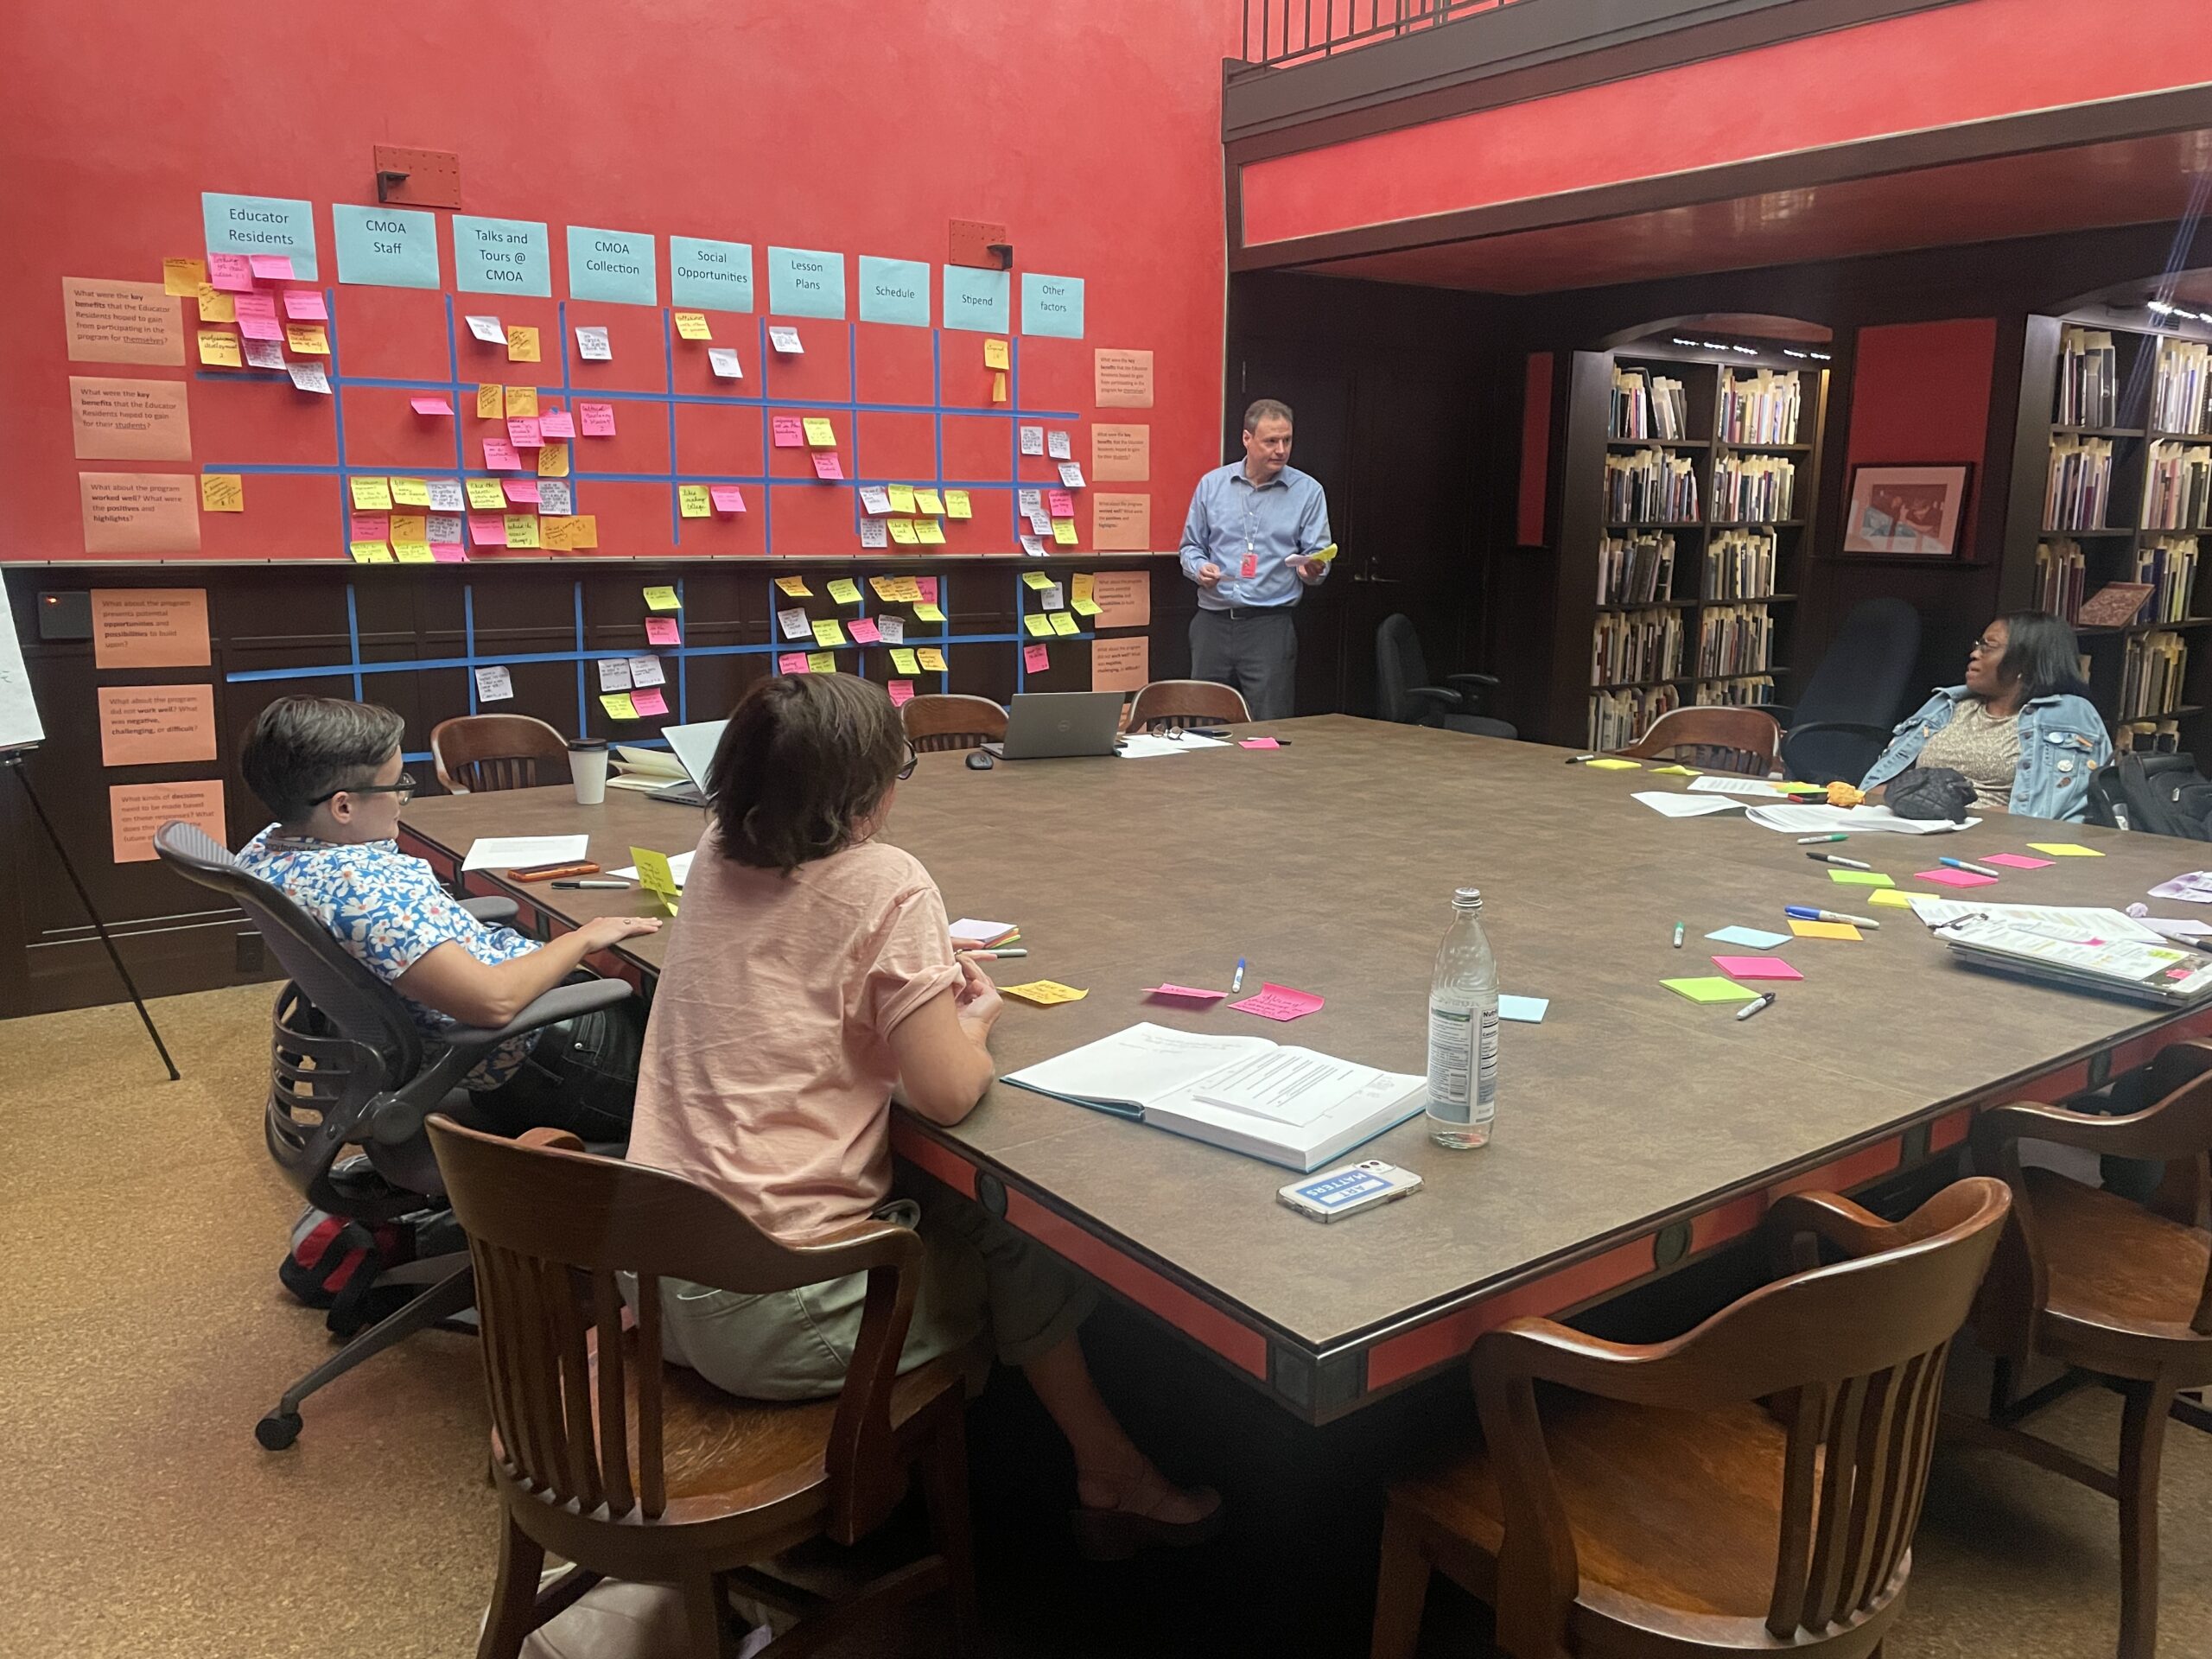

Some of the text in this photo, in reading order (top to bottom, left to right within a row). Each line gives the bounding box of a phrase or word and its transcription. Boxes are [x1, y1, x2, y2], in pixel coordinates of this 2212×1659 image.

[230, 208, 289, 223] Educator
[365, 220, 406, 234] CMOA
[229, 230, 293, 245] Residents
[475, 230, 528, 244] Talks and
[374, 242, 402, 254] Staff
[595, 242, 629, 254] CMOA
[480, 249, 525, 264] Tours @
[697, 251, 727, 263] Social
[587, 260, 639, 274] Collection
[791, 260, 823, 273] Lesson
[486, 270, 524, 282] CMOA
[677, 267, 747, 283] Opportunities
[796, 278, 821, 291] Plans
[1042, 285, 1065, 297] Other
[875, 286, 915, 300] Schedule
[962, 294, 993, 308] Stipend
[1039, 301, 1067, 313] factors
[97, 324, 142, 333] participating
[1306, 1173, 1368, 1196] MATTERS
[1341, 1185, 1366, 1197] ART
